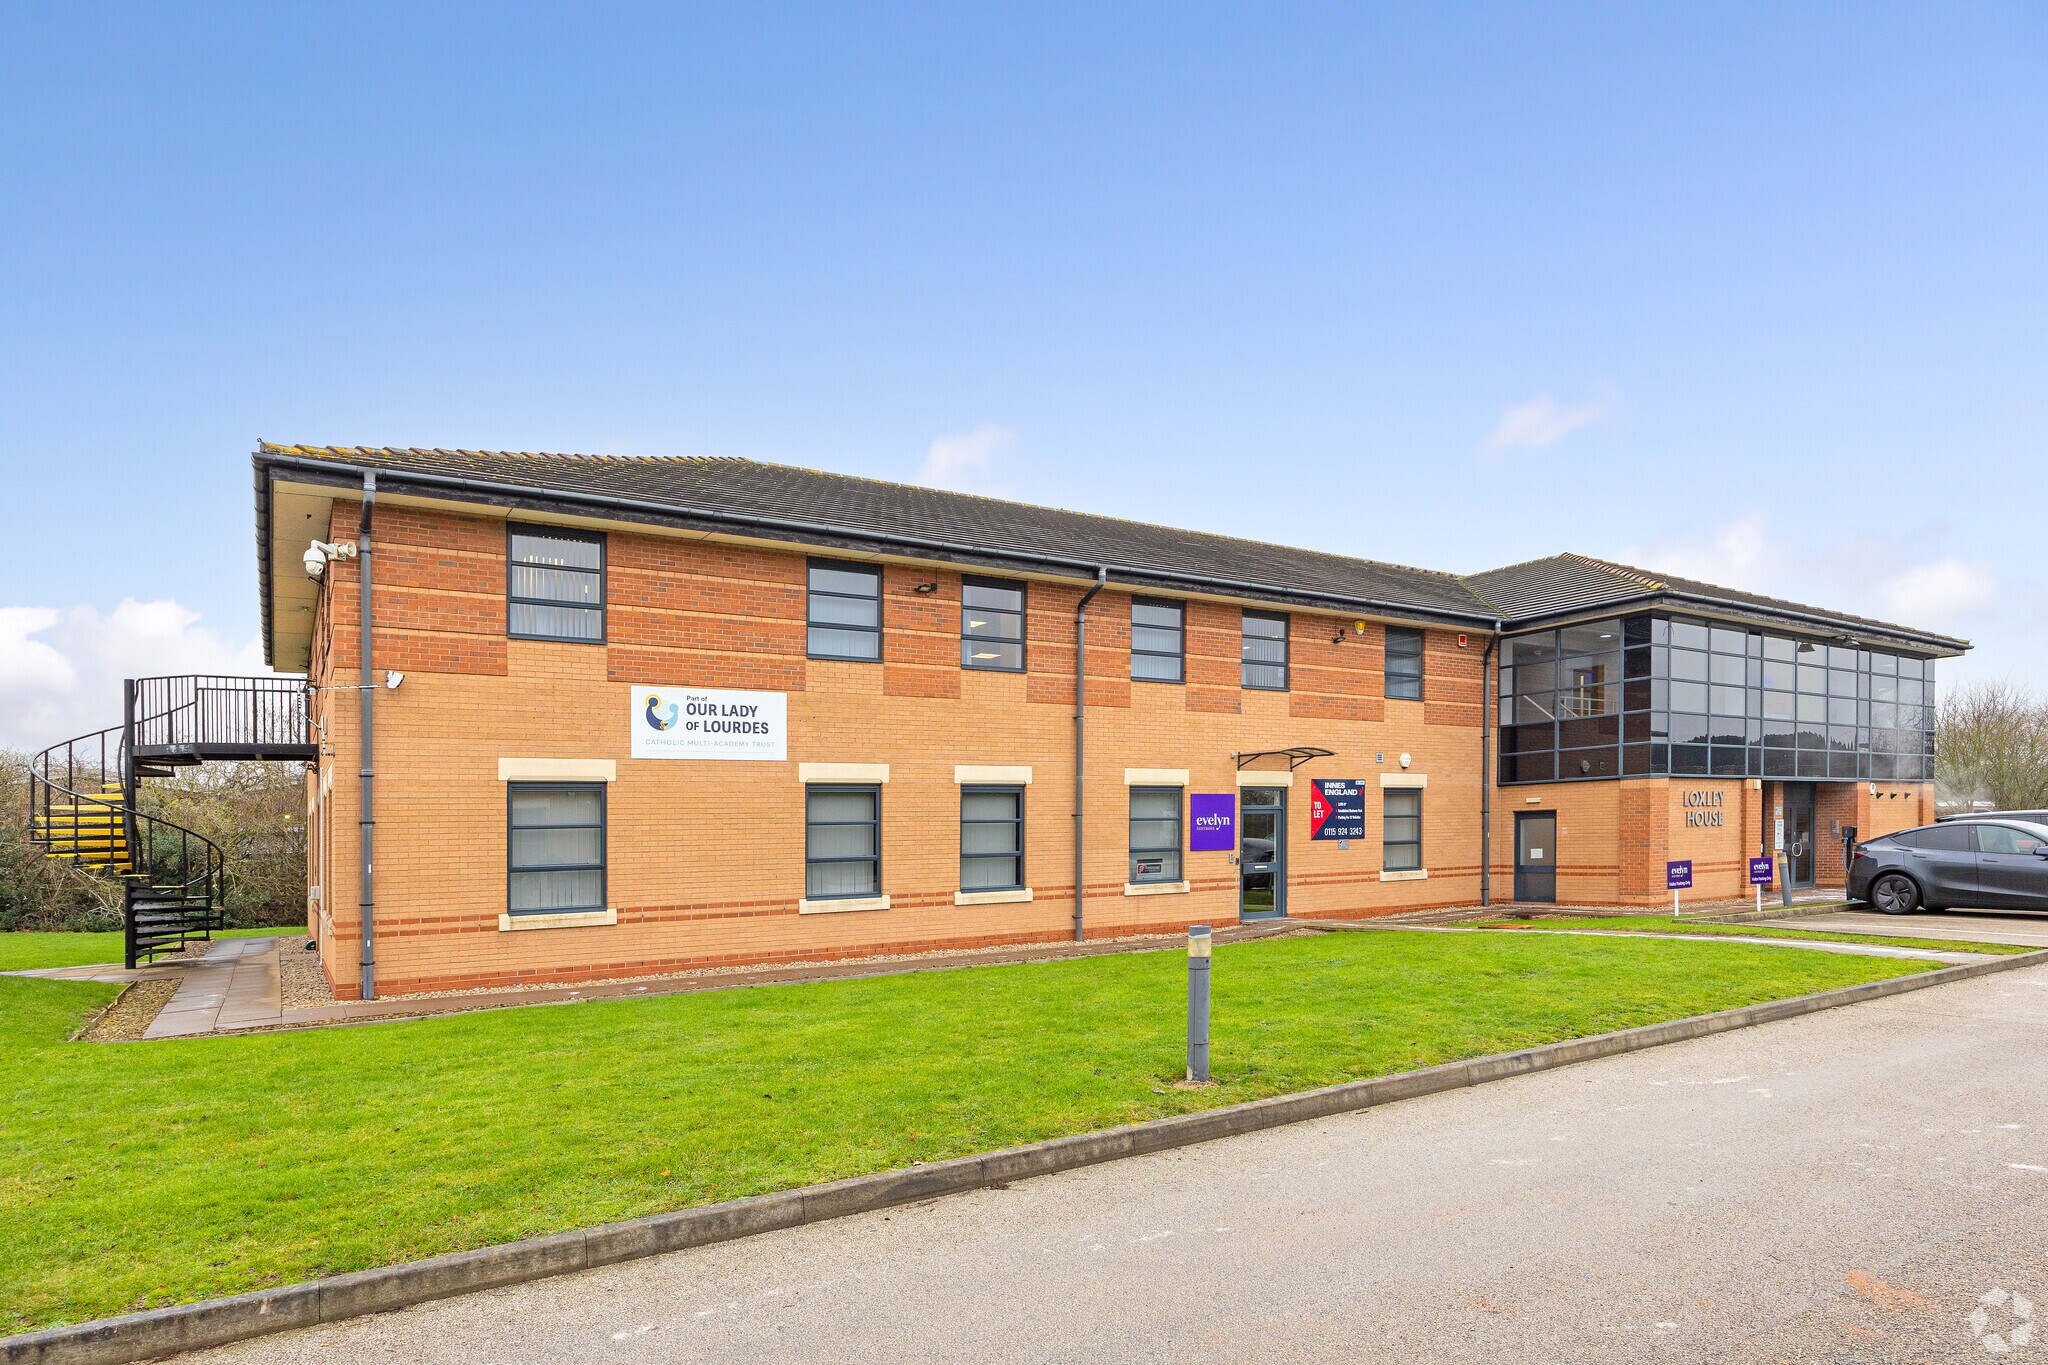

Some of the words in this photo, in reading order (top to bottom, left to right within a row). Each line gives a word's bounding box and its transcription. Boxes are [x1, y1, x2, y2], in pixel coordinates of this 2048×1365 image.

[686, 702, 718, 716] OUR
[721, 704, 758, 718] LADY
[686, 721, 700, 730] OF
[704, 720, 769, 734] LOURDES
[1314, 802, 1322, 810] TO
[1683, 791, 1724, 807] LOXLEY
[1314, 810, 1324, 818] LET
[1686, 811, 1724, 827] HOUSE
[1196, 813, 1230, 830] evelyn
[1324, 828, 1336, 836] 0115
[1338, 828, 1348, 836] 924
[1350, 828, 1362, 836] 3243
[1672, 865, 1688, 877] evelyn
